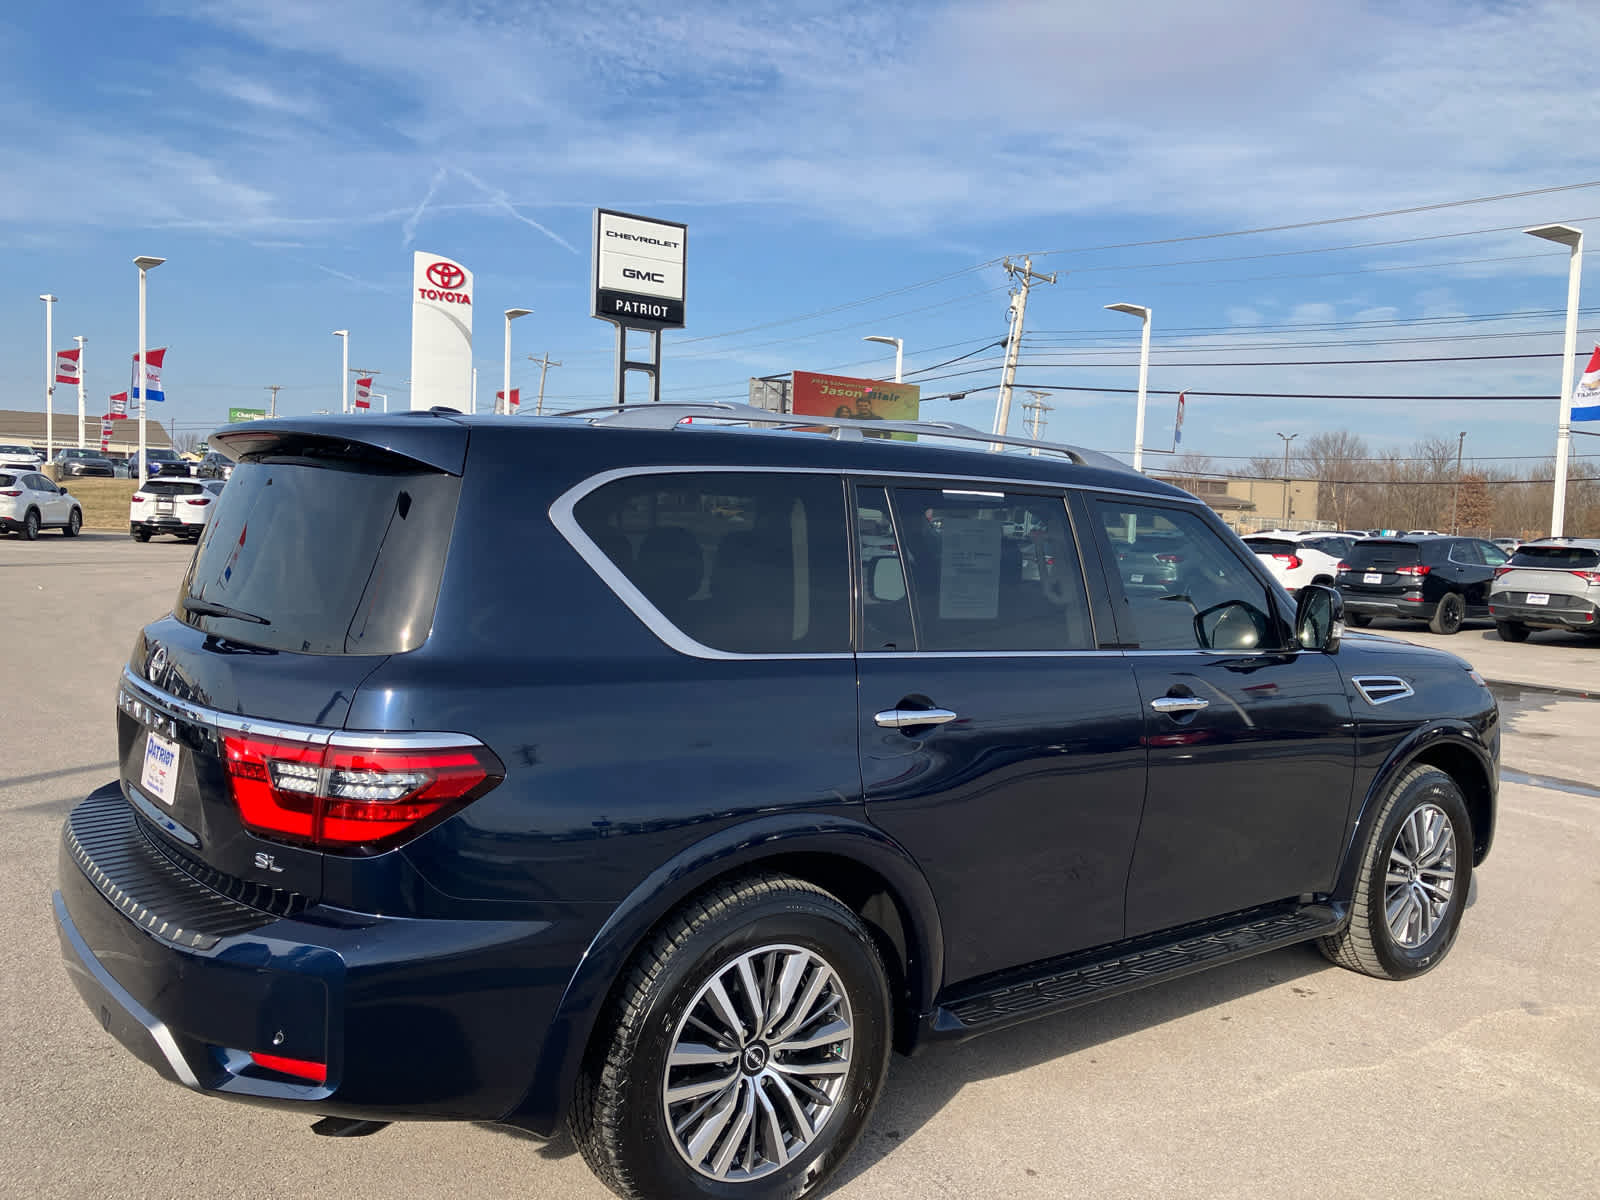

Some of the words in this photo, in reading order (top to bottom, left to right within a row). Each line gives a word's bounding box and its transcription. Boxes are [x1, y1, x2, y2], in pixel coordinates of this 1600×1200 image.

[605, 229, 680, 249] CHEVROLET
[622, 267, 665, 284] GMC
[418, 287, 472, 306] TOYOTA
[615, 299, 669, 318] PATRIOT
[820, 385, 863, 398] Jason
[147, 738, 174, 766] PATRIOT
[254, 852, 285, 872] SL
